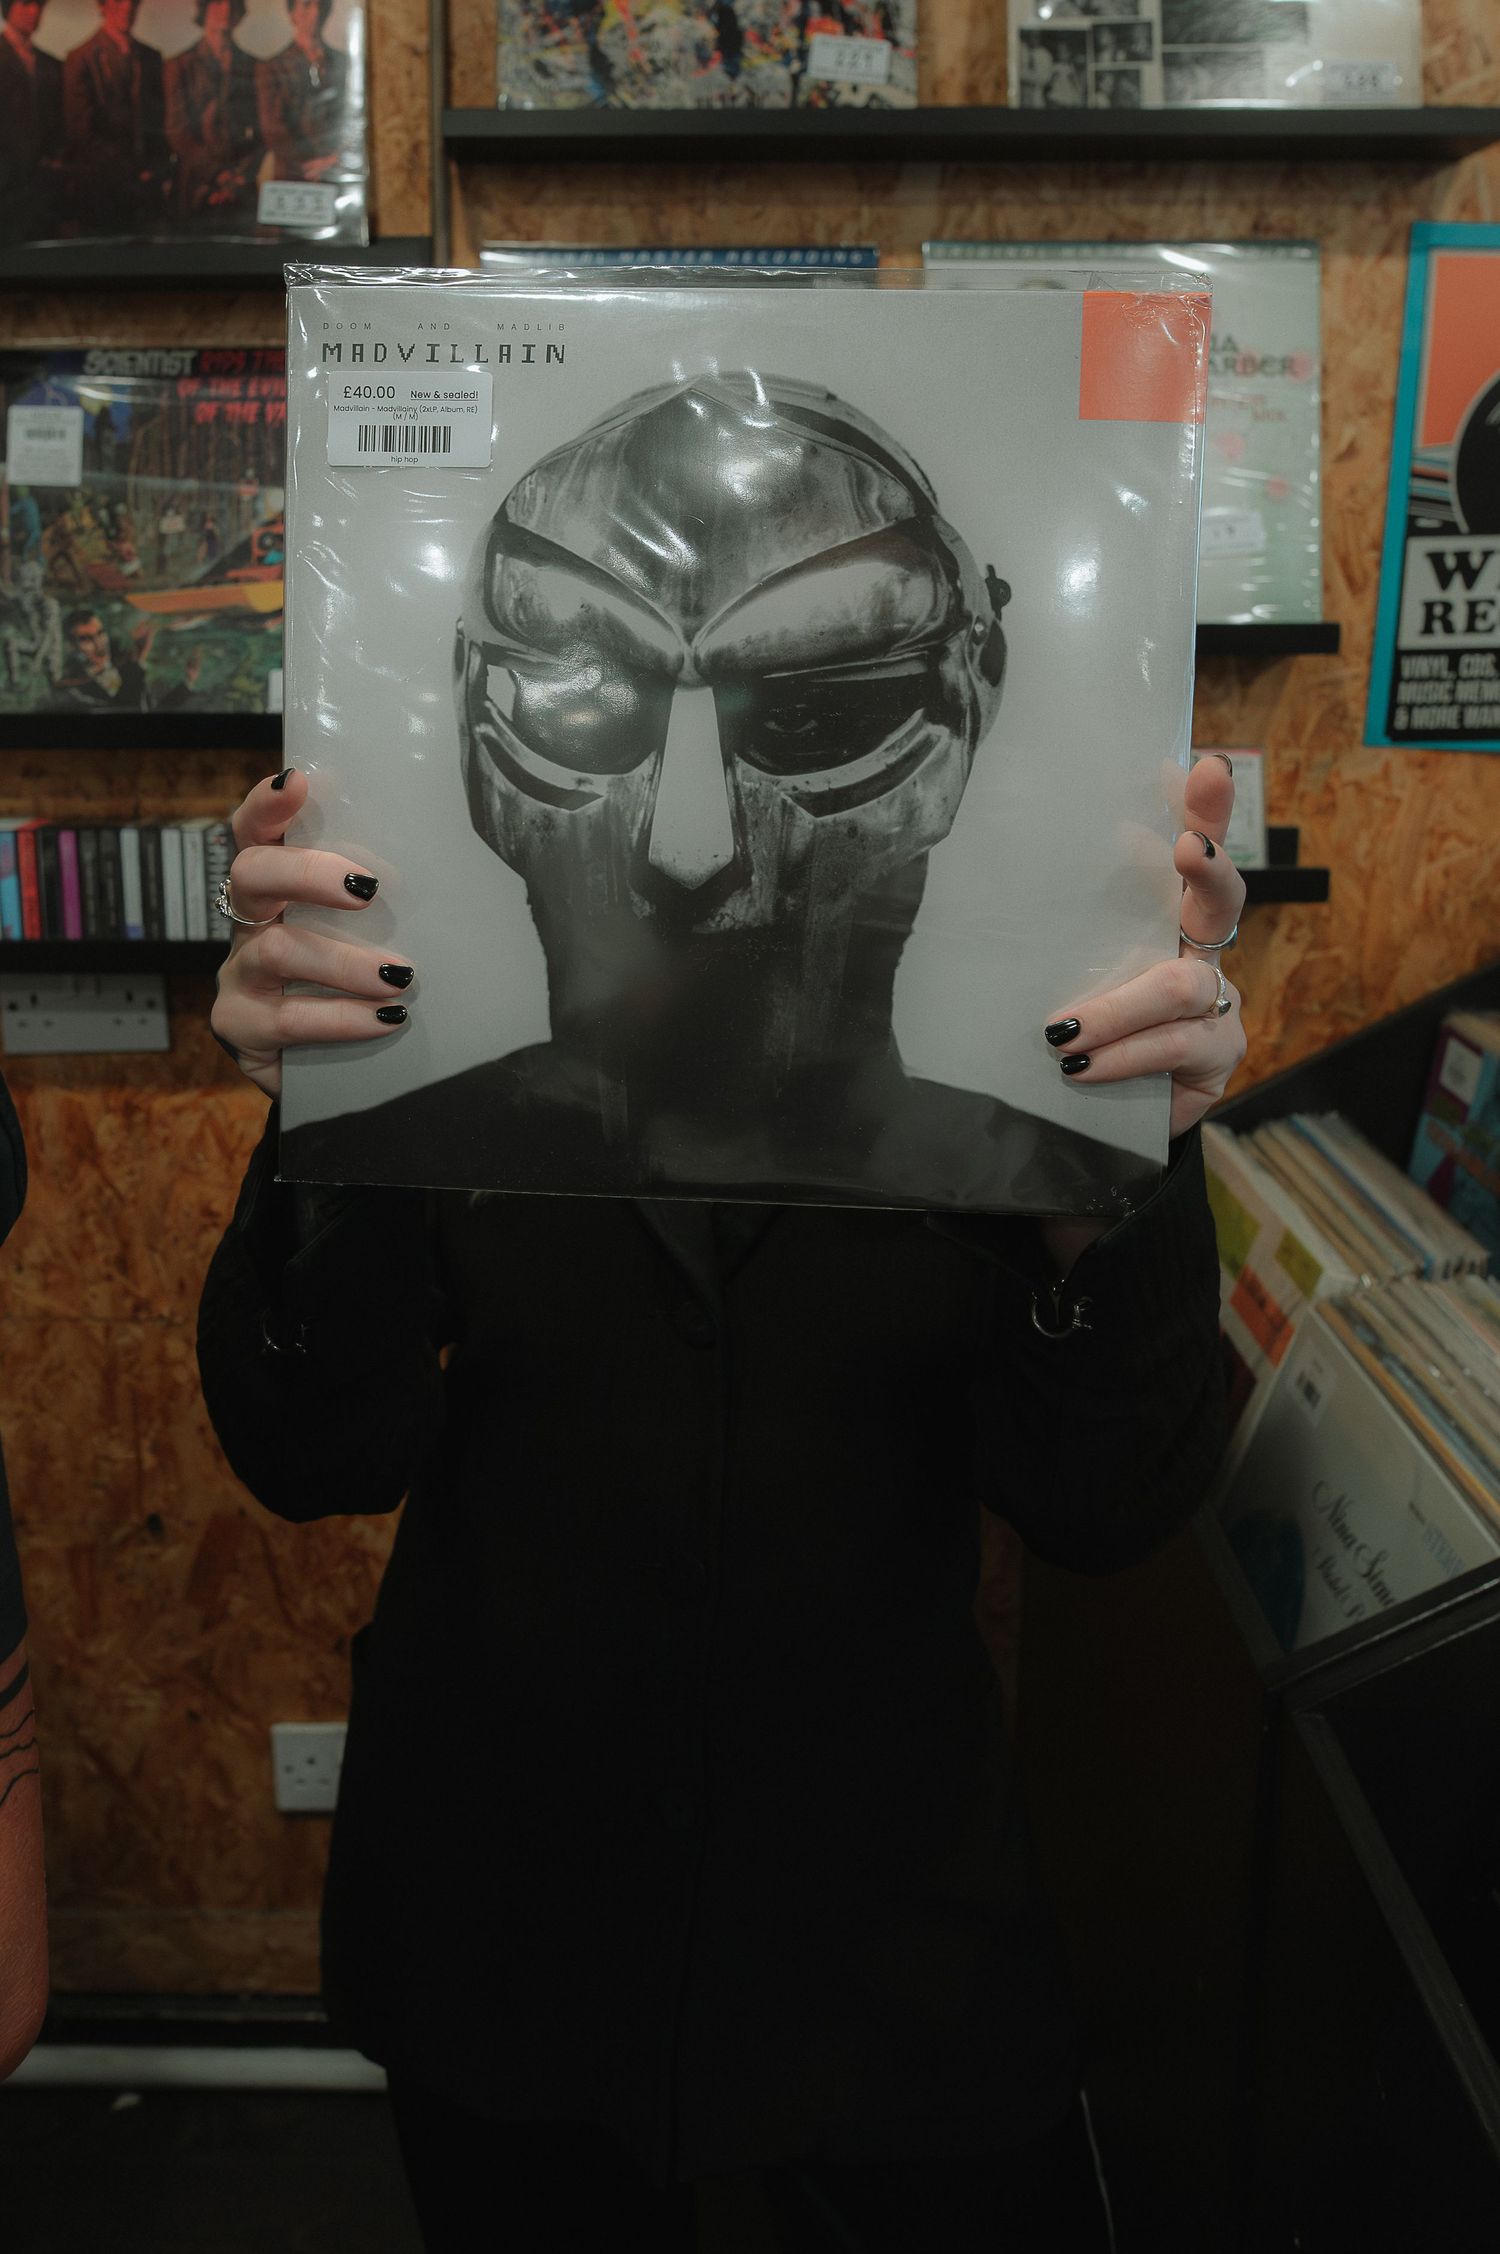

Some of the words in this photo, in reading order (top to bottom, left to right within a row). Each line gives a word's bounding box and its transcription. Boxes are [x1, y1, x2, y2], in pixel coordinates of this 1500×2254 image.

[323, 322, 371, 330] DOOM
[418, 322, 450, 331] AND
[497, 323, 565, 331] MADLIB
[322, 343, 565, 364] MADVILLAIN
[84, 350, 198, 375] SCIENTIST
[343, 386, 396, 400] £40.00
[410, 390, 431, 400] New
[433, 390, 441, 400] &
[443, 390, 479, 400] sealed!
[377, 405, 417, 414] Madvillainy
[419, 405, 438, 414] (2xLP,
[440, 405, 464, 414] Album,
[466, 405, 478, 414] RE)
[392, 413, 402, 421] (M
[409, 413, 419, 421] M)
[391, 455, 403, 464] hip
[404, 455, 419, 464] hop
[1424, 549, 1500, 591] W
[1419, 599, 1500, 637] RE
